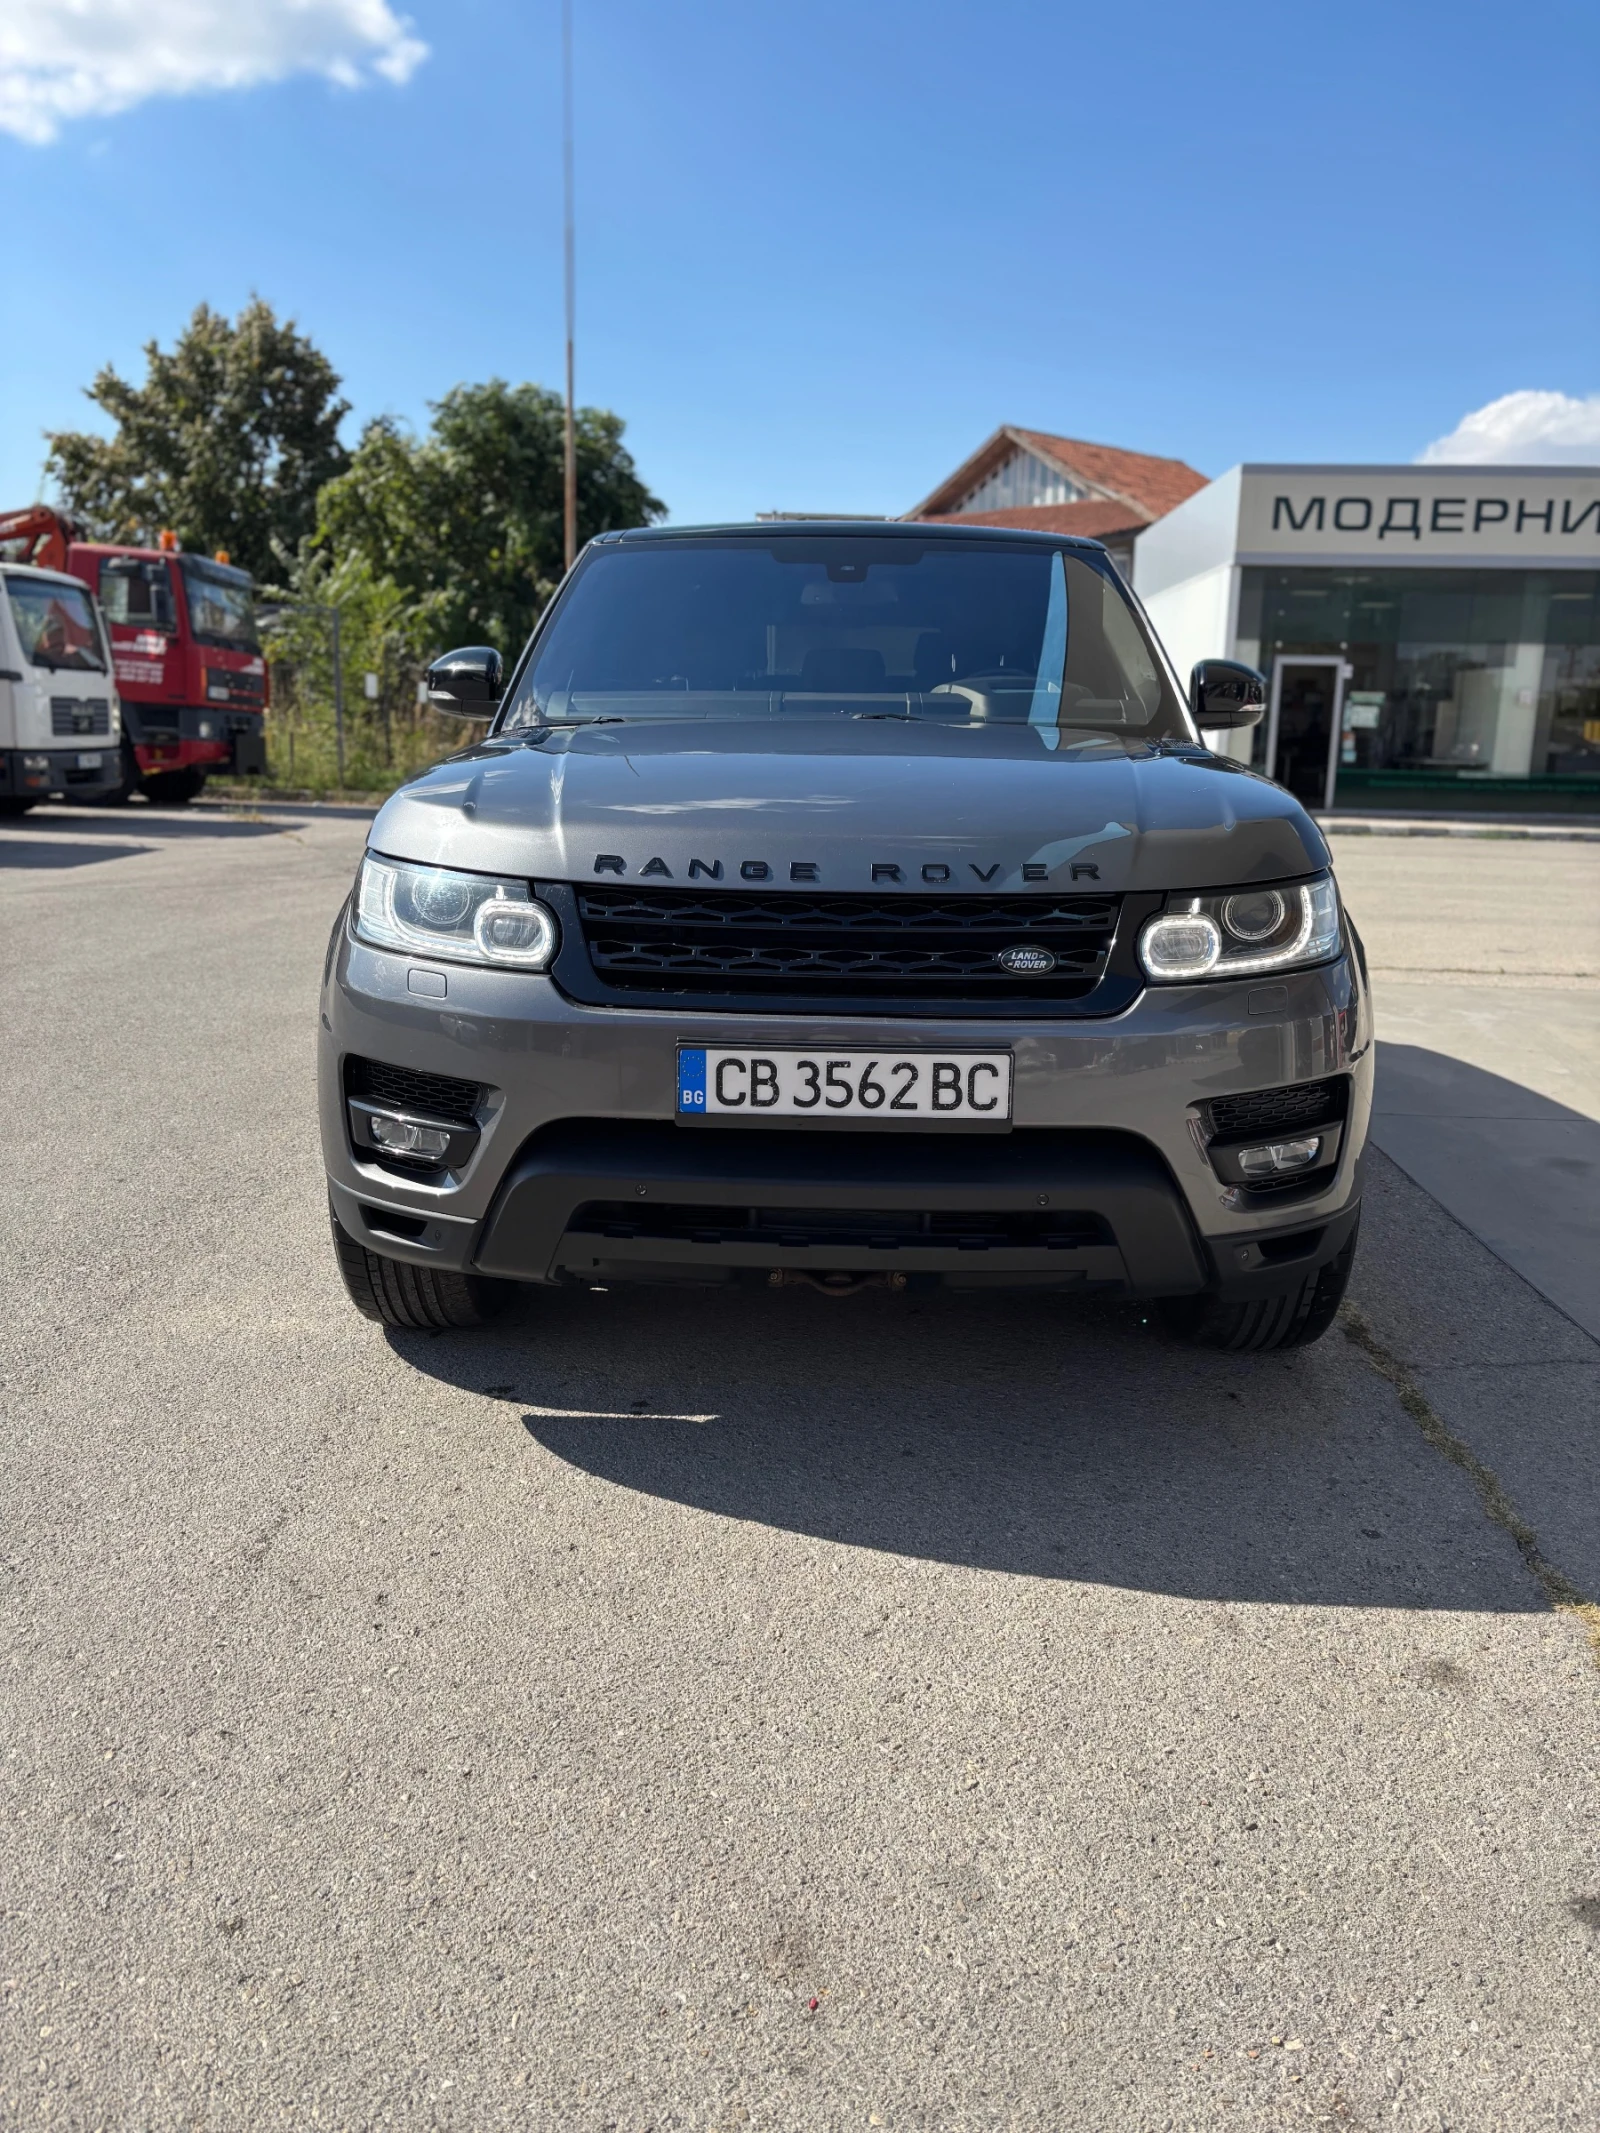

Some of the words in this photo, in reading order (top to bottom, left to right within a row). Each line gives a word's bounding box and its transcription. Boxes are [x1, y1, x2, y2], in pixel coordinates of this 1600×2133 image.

[1272, 496, 1600, 540] МОДЕРНИ
[594, 854, 817, 881] RANGE
[871, 862, 1101, 882] ROVER
[1011, 952, 1038, 960] LAND
[1013, 960, 1047, 968] ROVER
[715, 1058, 780, 1107] CB
[793, 1060, 919, 1110] 3562
[931, 1062, 999, 1111] BC
[682, 1090, 704, 1105] BG
